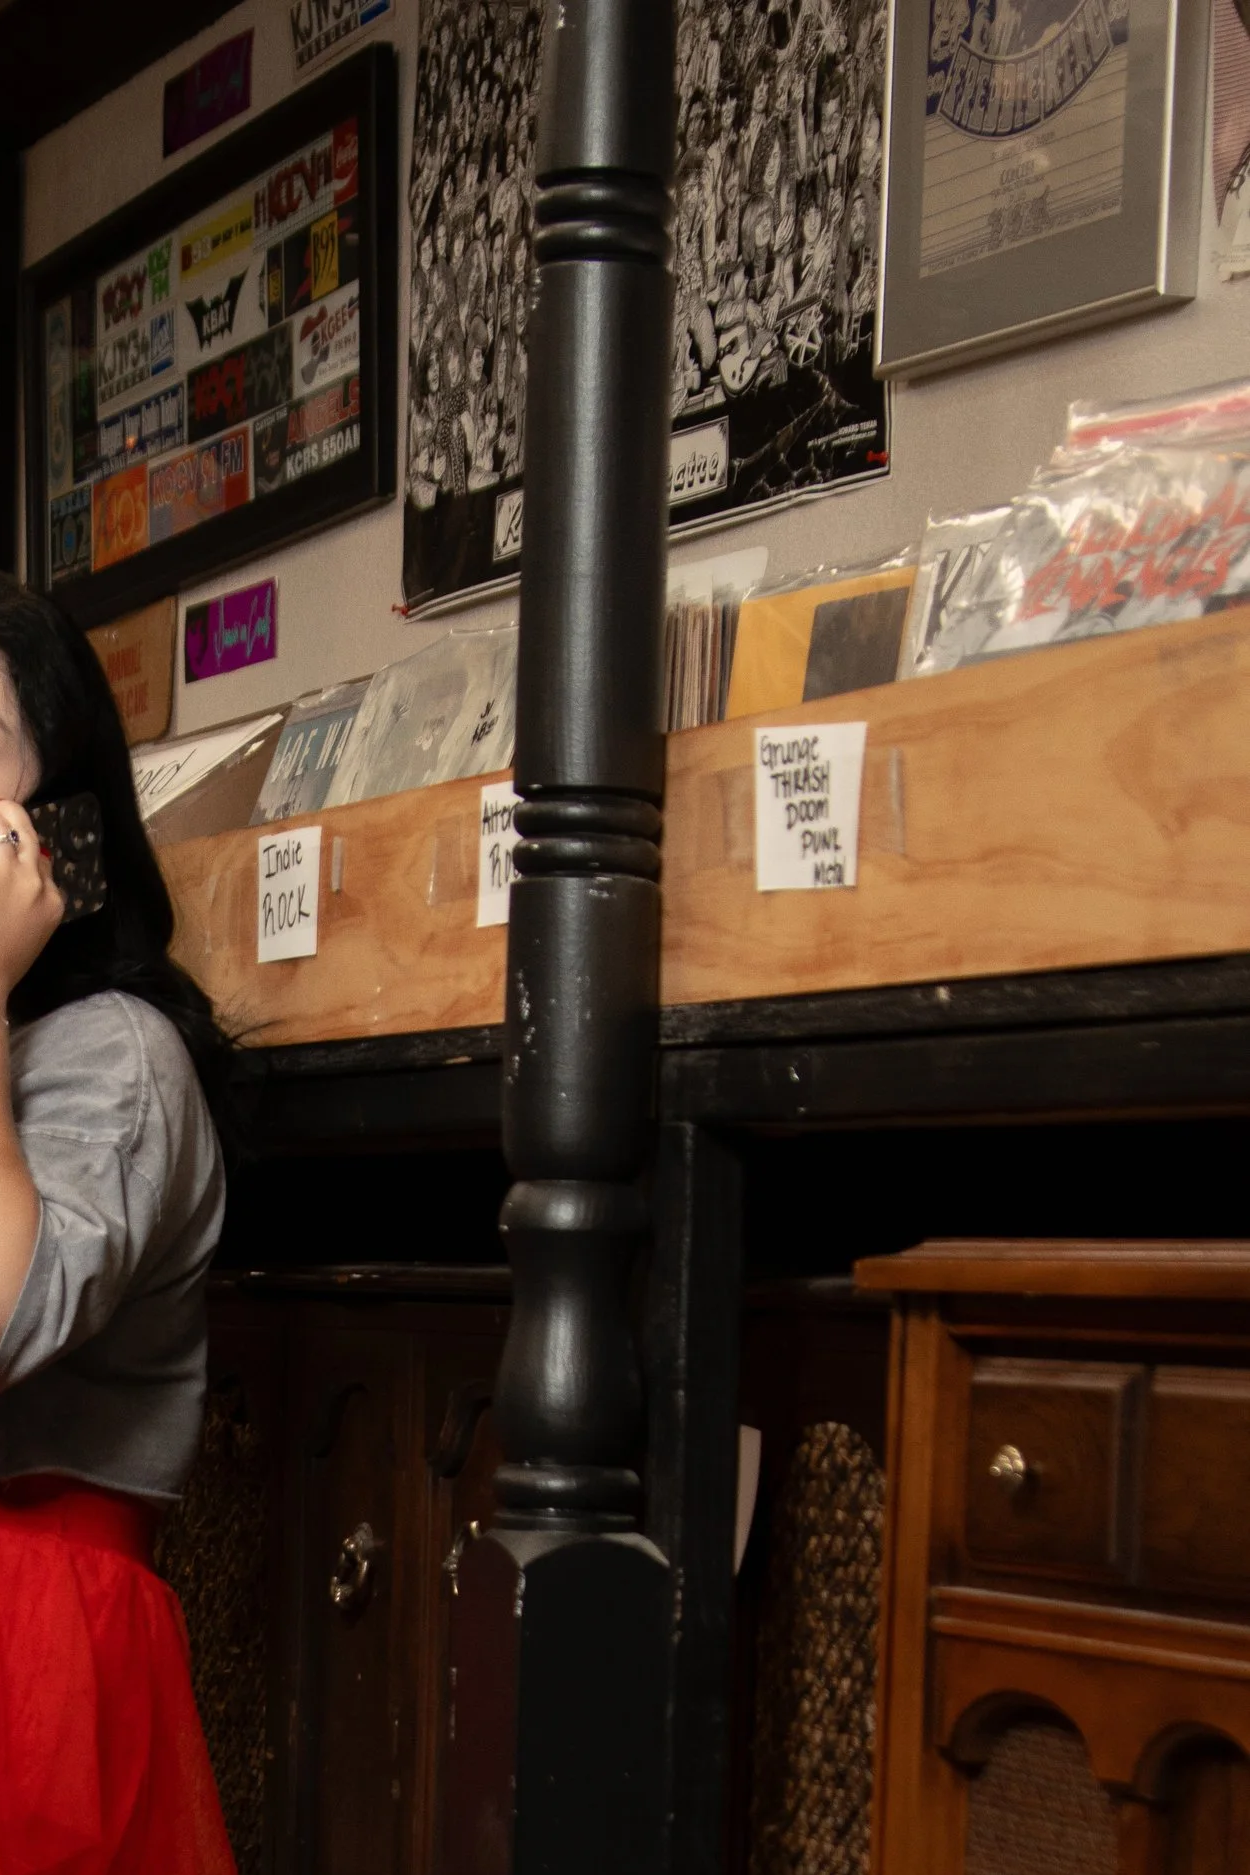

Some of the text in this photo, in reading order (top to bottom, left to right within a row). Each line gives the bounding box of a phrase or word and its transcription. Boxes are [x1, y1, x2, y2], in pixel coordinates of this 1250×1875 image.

[941, 0, 1113, 136] FREDDIE KING
[202, 300, 231, 338] KBAT
[321, 304, 348, 345] KGEE
[287, 375, 360, 447] ANGELS
[221, 434, 244, 479] FM
[285, 446, 320, 481] KCRS
[271, 726, 319, 784] JOE
[760, 734, 820, 771] Grunge
[770, 759, 831, 799] THRASH
[785, 798, 830, 830] DOOM
[262, 838, 304, 879] Indie
[261, 882, 311, 939] ROCK
